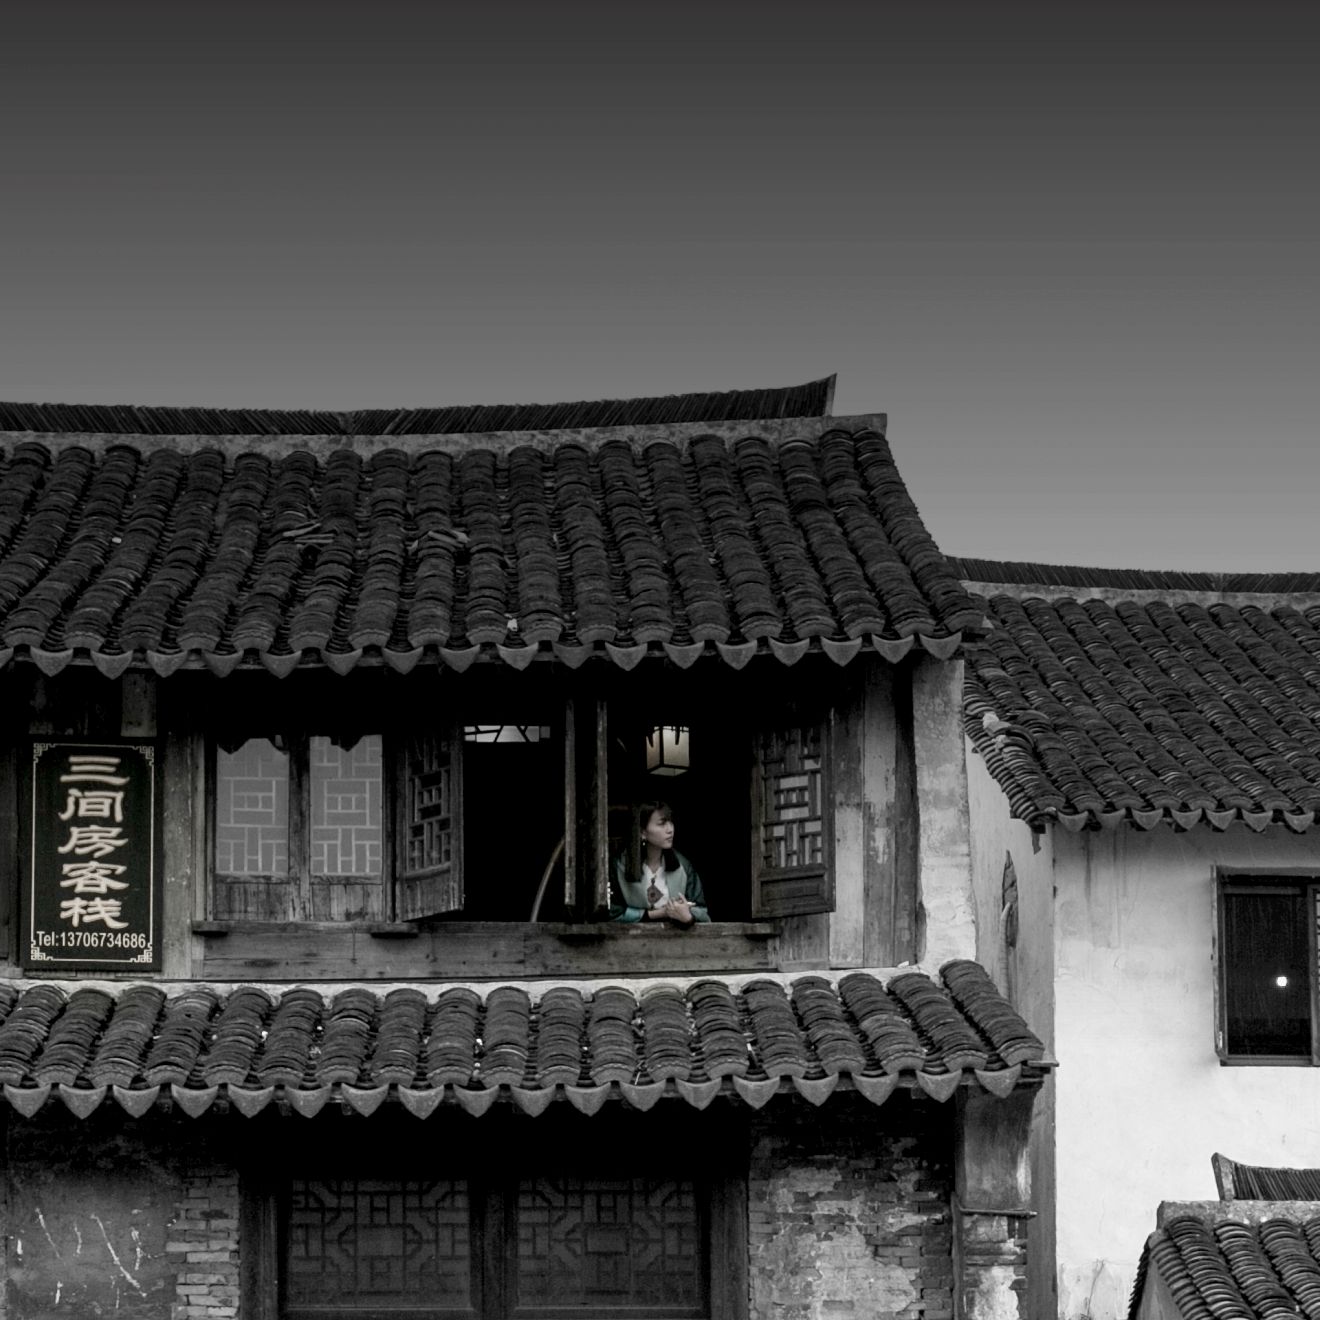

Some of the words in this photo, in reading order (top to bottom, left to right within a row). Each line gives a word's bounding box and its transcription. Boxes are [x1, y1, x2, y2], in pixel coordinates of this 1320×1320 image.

[58, 756, 130, 929] 三间房客栈
[36, 930, 146, 949] Tel:13706734686
